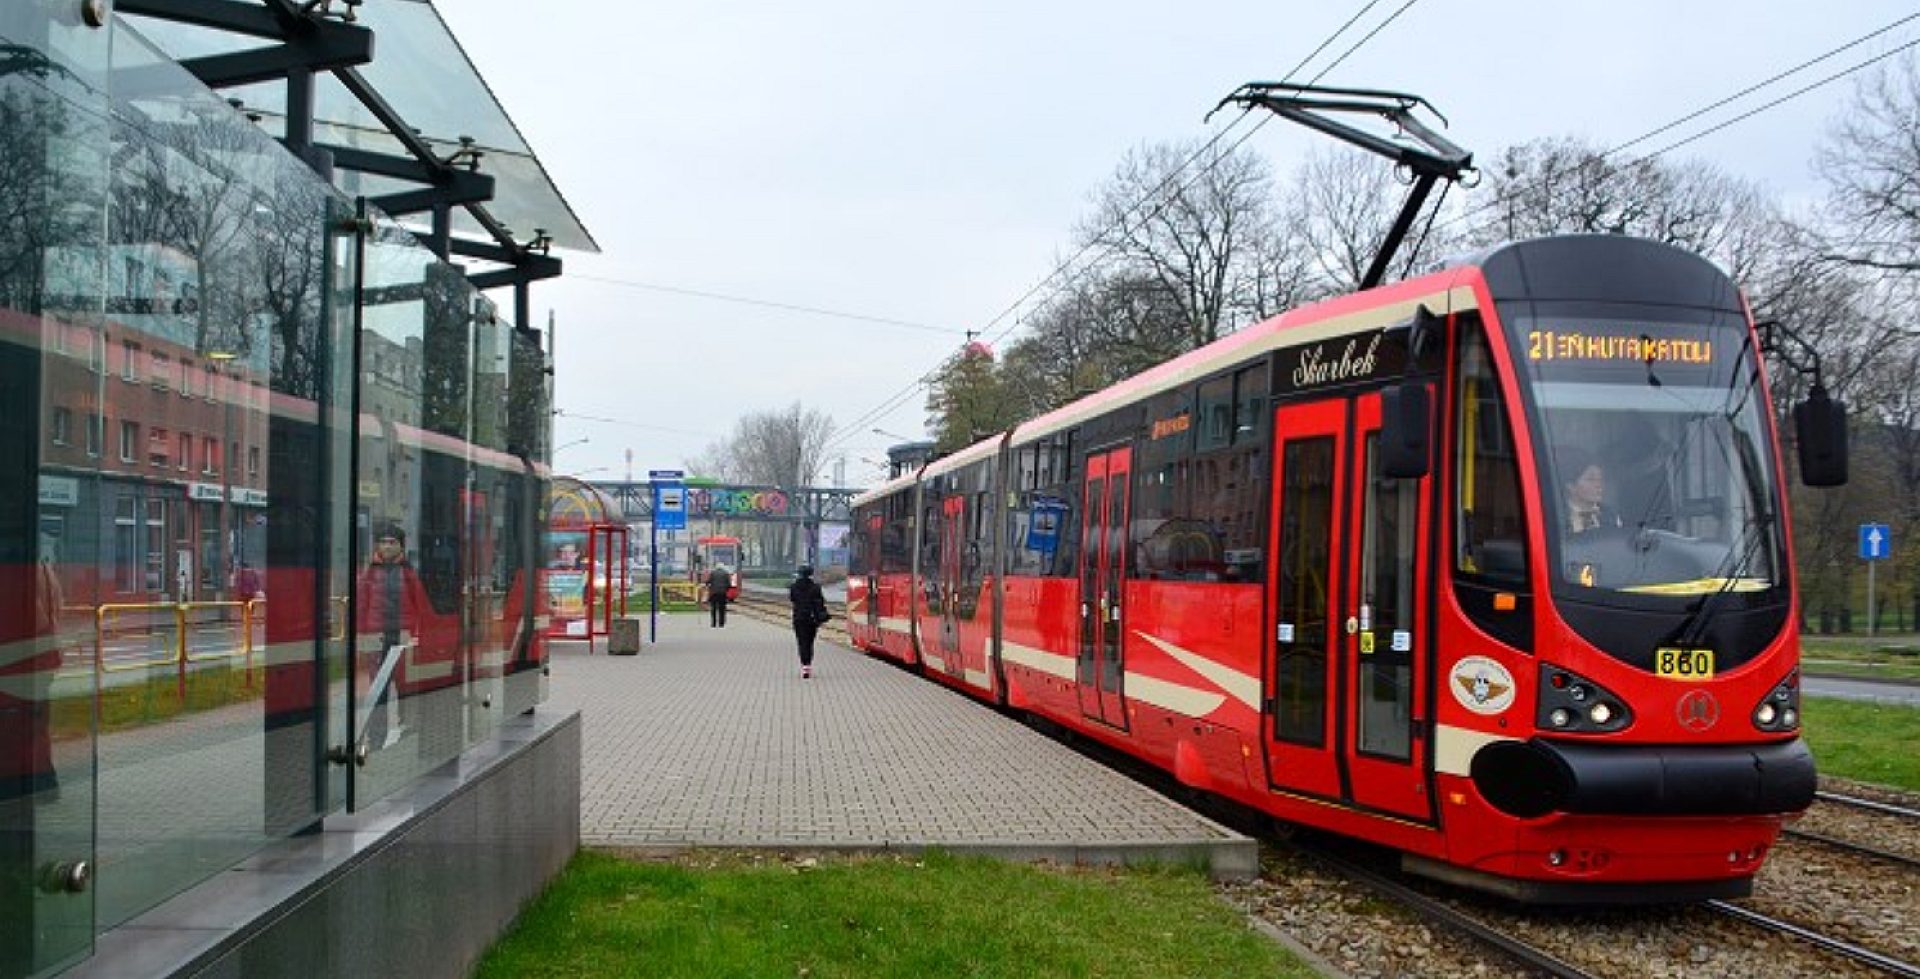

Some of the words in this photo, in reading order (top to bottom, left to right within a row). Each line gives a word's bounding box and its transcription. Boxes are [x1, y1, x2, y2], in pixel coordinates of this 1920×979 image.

[1293, 334, 1381, 386] Skarbek
[1529, 331, 1553, 359] 21
[1587, 336, 1638, 360] HUTA
[1663, 653, 1708, 674] 860
